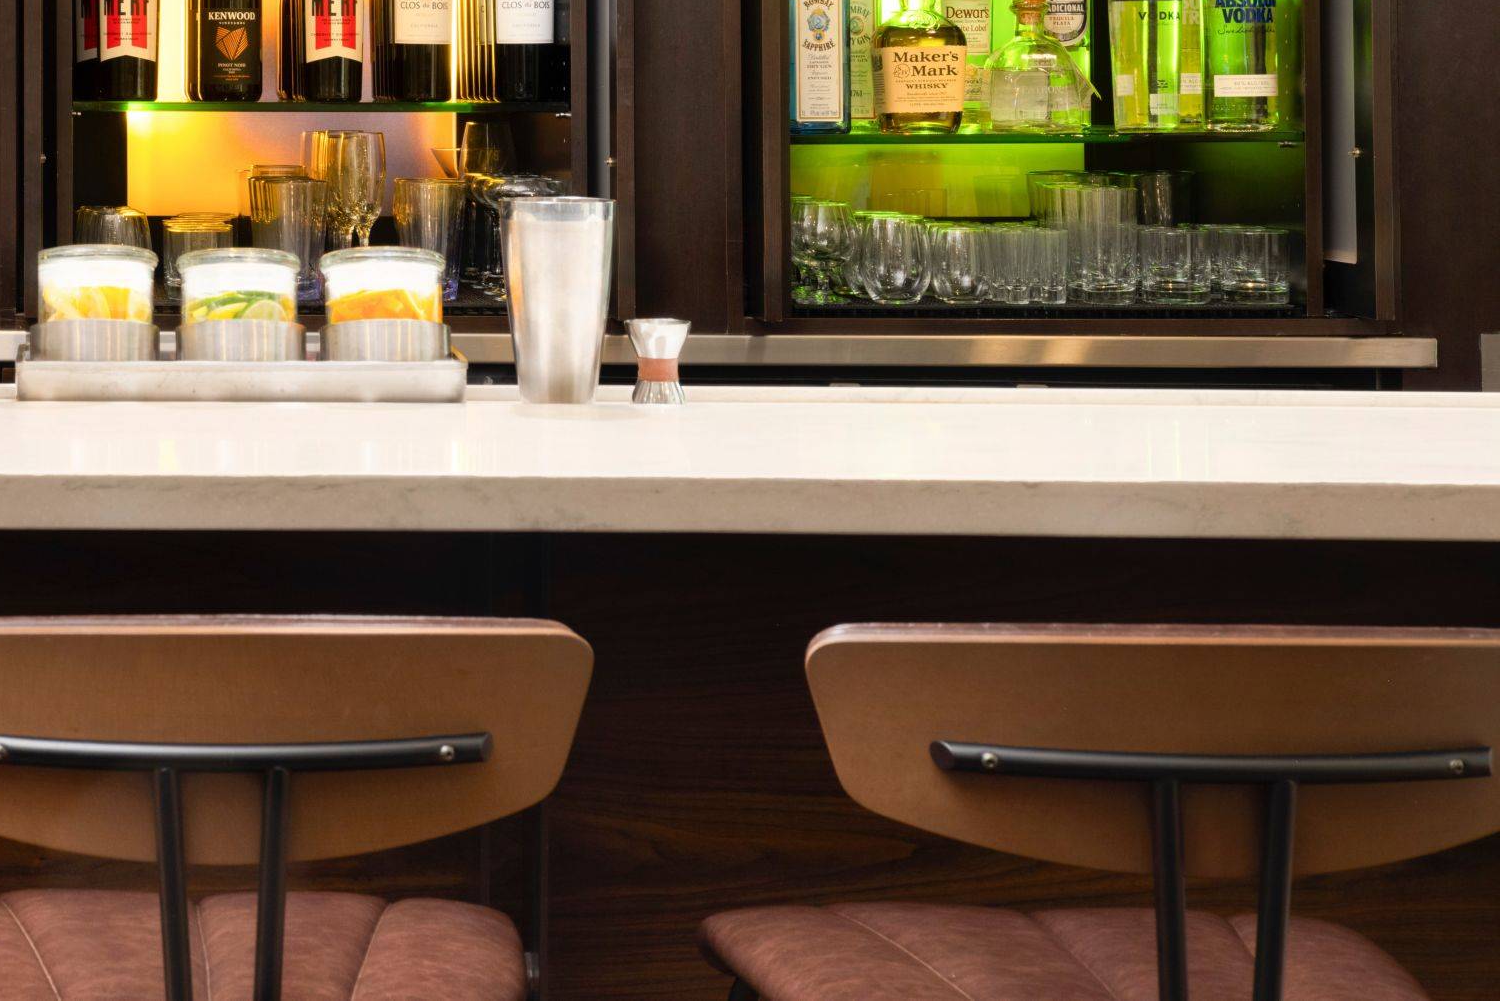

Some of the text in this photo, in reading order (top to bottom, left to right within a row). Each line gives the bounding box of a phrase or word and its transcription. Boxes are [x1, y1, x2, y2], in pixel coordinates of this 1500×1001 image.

[400, 1, 449, 10] CLOS BOIS
[501, 0, 550, 9] CLOS BOIS
[208, 11, 256, 21] KENWOOD
[945, 6, 990, 19] Dewar's
[1138, 11, 1181, 21] VDKA
[1221, 7, 1274, 24] VODKA
[970, 23, 987, 32] Label
[802, 38, 836, 52] SAPPHIRE
[892, 51, 959, 63] Maker's
[911, 64, 958, 77] Mark
[905, 82, 948, 90] WHISKY
